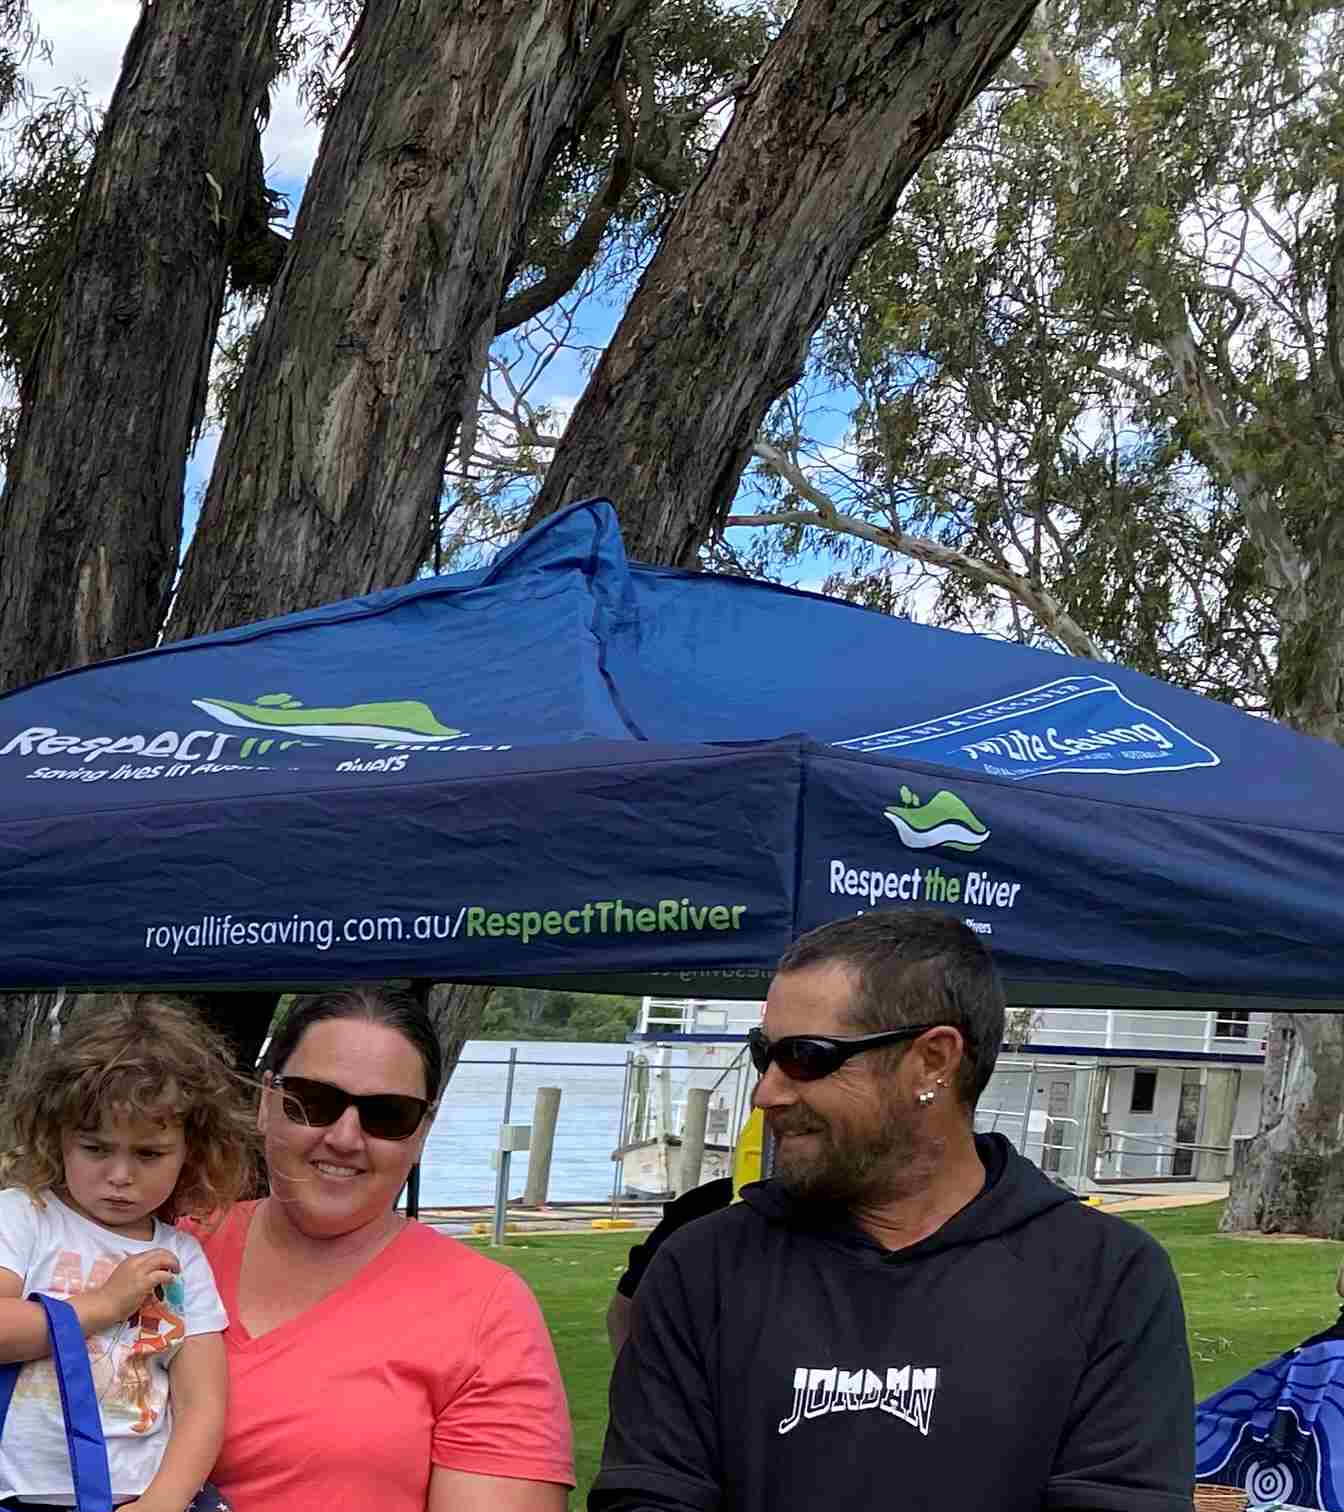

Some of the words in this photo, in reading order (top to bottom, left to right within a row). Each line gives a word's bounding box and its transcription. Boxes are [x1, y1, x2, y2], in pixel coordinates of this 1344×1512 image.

[1046, 723, 1174, 756] Saving
[26, 764, 111, 783] Saving
[110, 764, 161, 780] lives
[830, 859, 921, 907] Respect
[925, 867, 961, 904] the
[964, 870, 1021, 908] River
[145, 898, 747, 953] royallifesaving.com.au/RespectTheRiver
[778, 1366, 936, 1436] JORDAN
